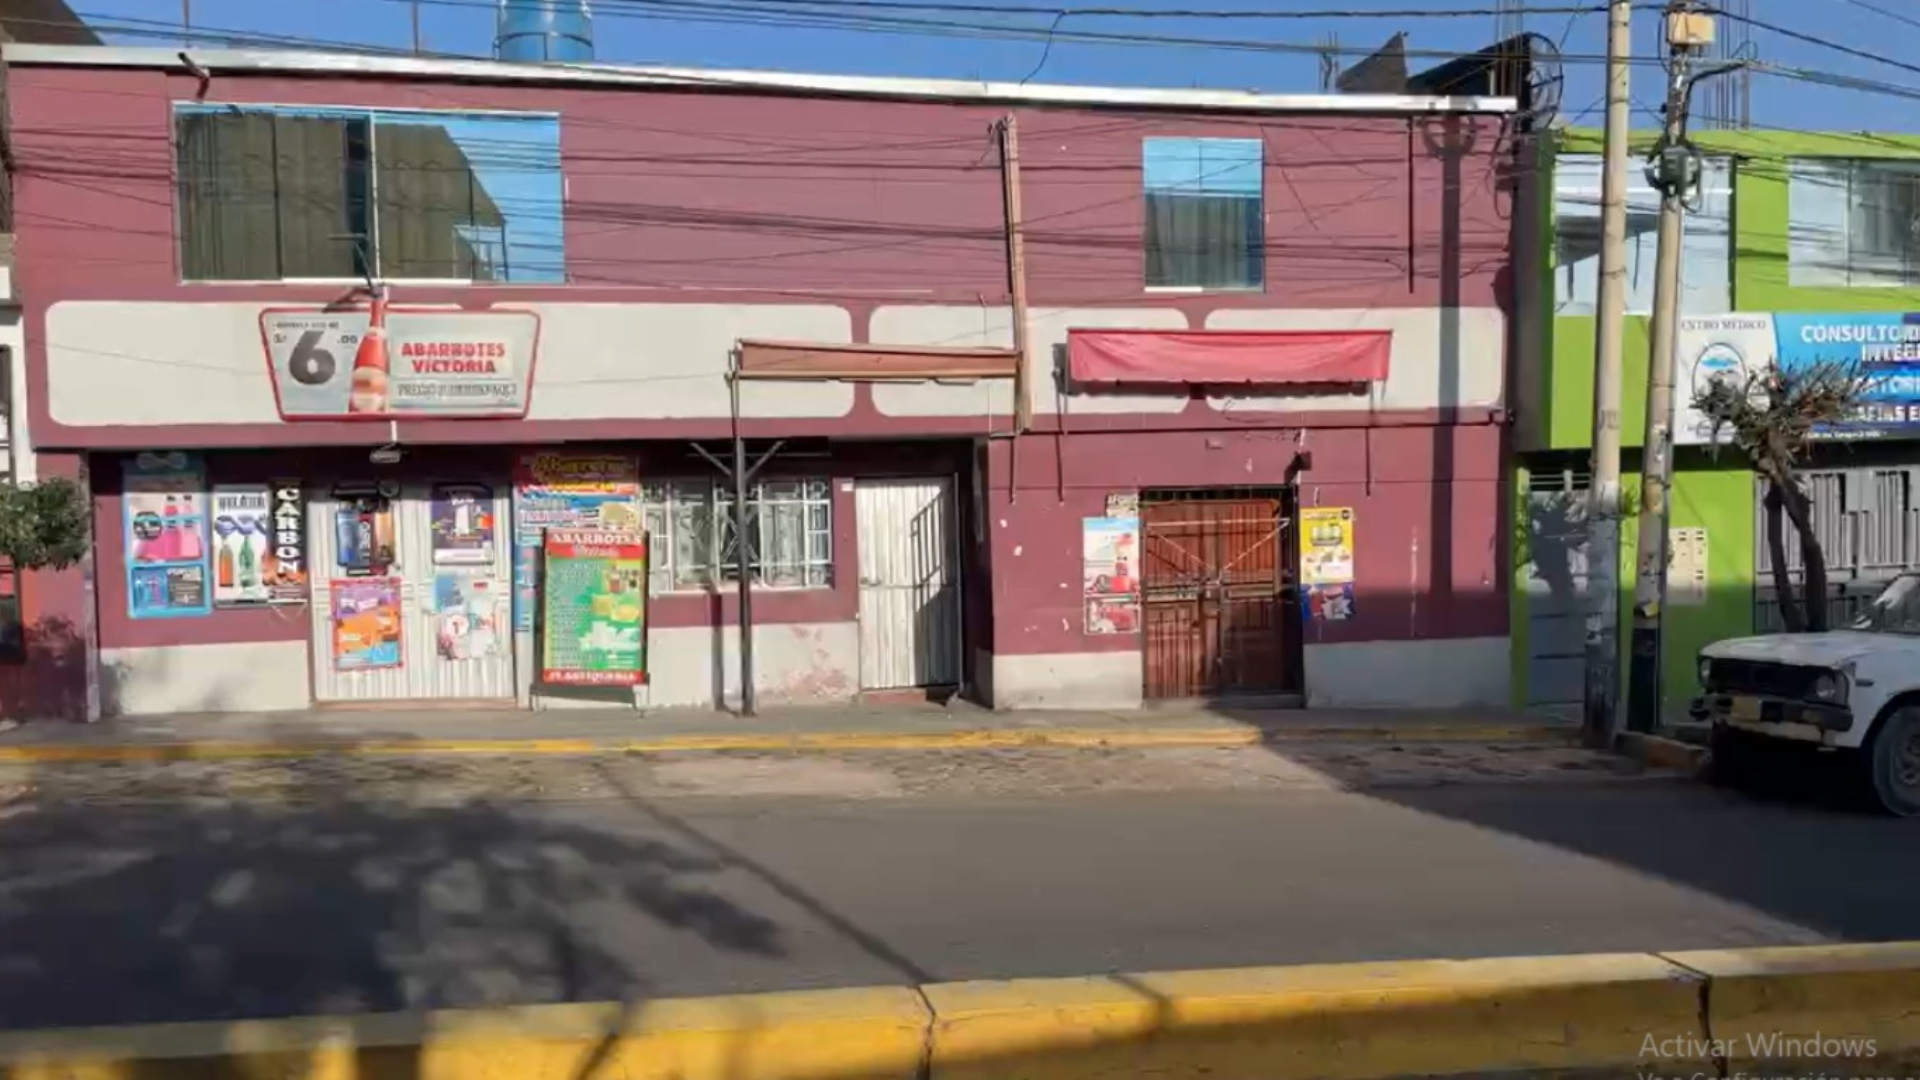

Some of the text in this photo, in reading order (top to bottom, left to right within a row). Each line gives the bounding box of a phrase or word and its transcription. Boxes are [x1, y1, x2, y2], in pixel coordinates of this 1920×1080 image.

[1680, 319, 1719, 331] ENTRO
[401, 342, 506, 357] ABARROTES
[288, 329, 336, 385] 6
[411, 359, 496, 373] VICTORIA
[275, 487, 302, 575] CARBON
[552, 531, 642, 545] ABARROTES
